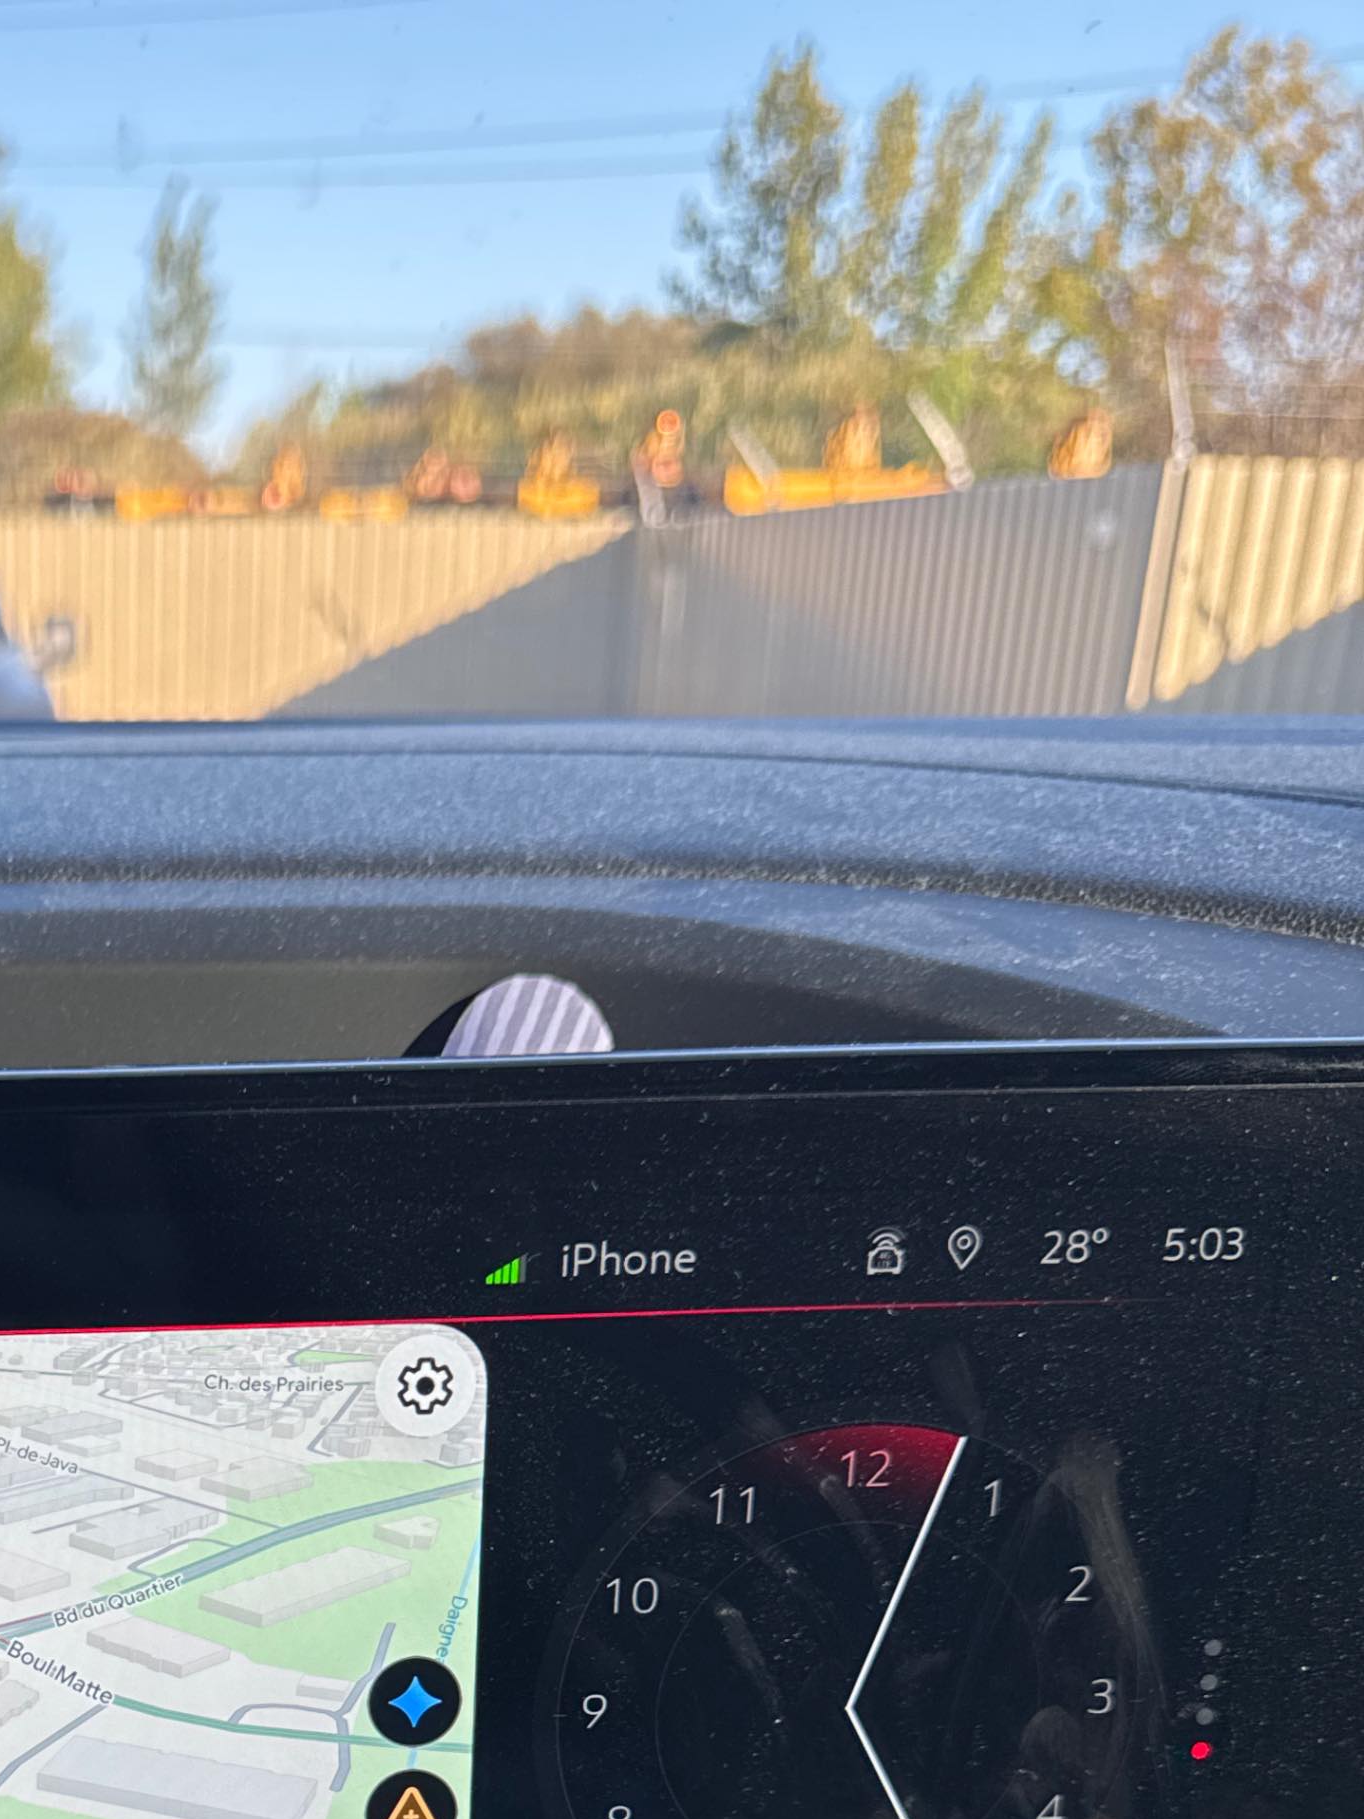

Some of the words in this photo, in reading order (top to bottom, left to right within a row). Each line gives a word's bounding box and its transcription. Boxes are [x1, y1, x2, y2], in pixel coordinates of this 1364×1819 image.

[561, 1240, 697, 1278] iPhone
[1162, 1226, 1244, 1262] 5:03
[203, 1374, 234, 1391] Ch.
[238, 1376, 272, 1392] des
[276, 1376, 344, 1392] Prairies
[17, 1445, 39, 1462] de
[40, 1452, 79, 1474] Java
[839, 1449, 893, 1488] 12
[708, 1486, 757, 1525] 11
[983, 1478, 1005, 1517] 1
[54, 1607, 79, 1628] Bd
[82, 1600, 106, 1619] du
[107, 1575, 183, 1611] Quartier
[604, 1577, 660, 1615] 10
[1064, 1566, 1093, 1602] 2
[436, 1595, 469, 1664] Daigne
[54, 1664, 114, 1705] Matte
[1086, 1678, 1116, 1715] 3
[581, 1693, 609, 1730] 9
